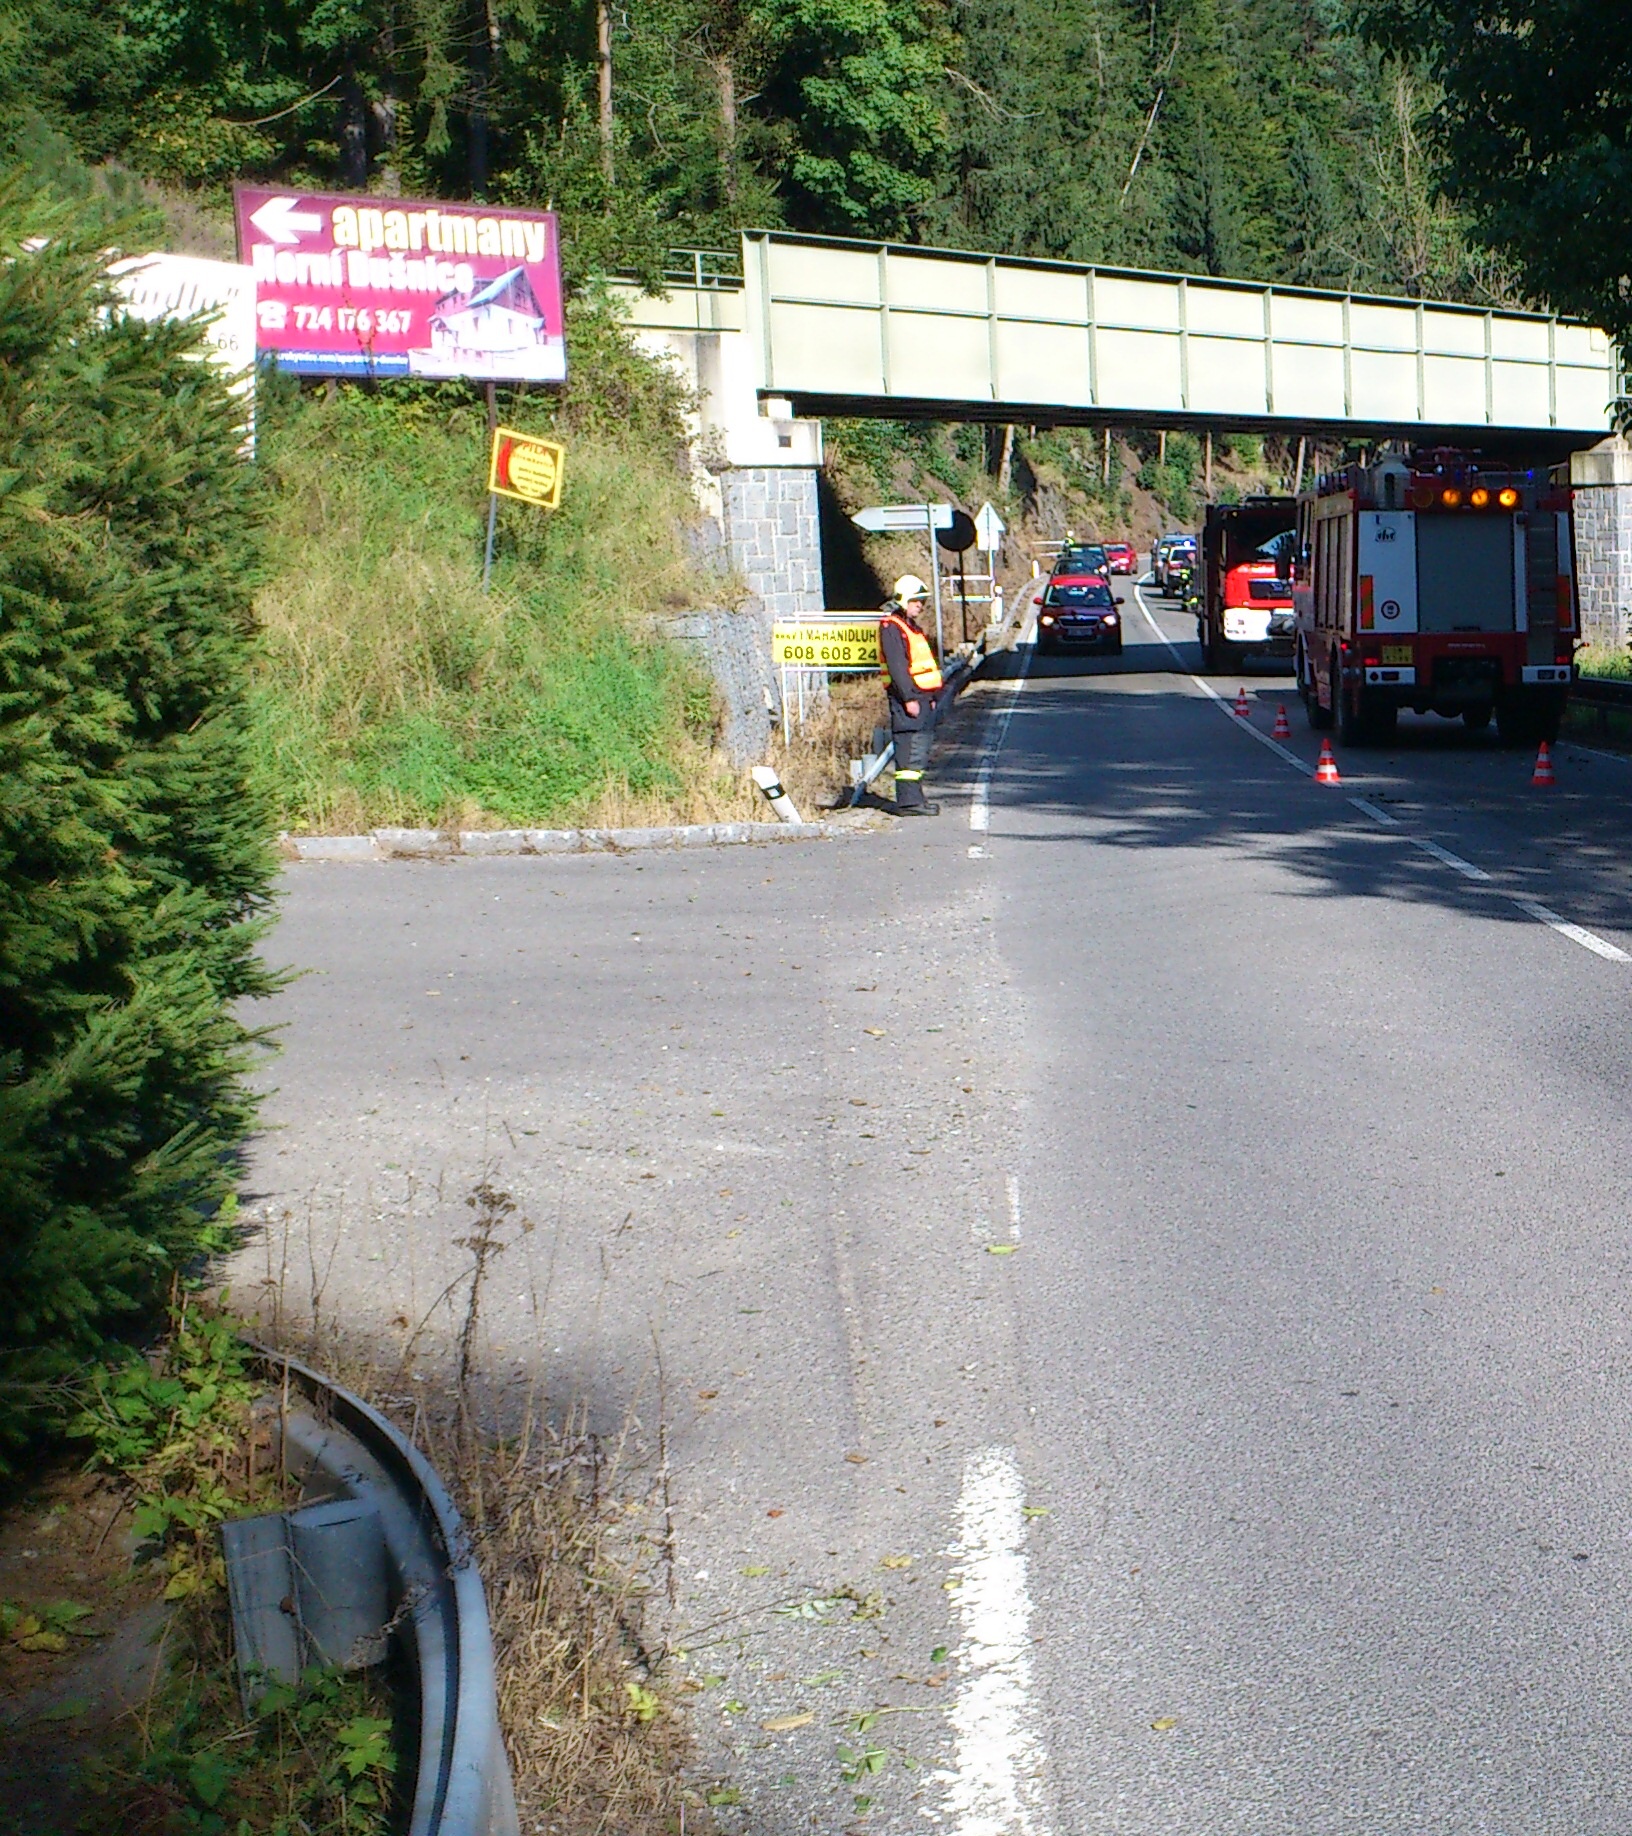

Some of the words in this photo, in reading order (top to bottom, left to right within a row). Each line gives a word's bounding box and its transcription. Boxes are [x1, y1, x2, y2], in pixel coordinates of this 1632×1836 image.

[332, 205, 546, 263] apartmany
[293, 306, 332, 330] 724
[338, 308, 372, 333] 176
[374, 309, 412, 333] 367
[783, 645, 815, 660] 608
[820, 646, 852, 661] 608
